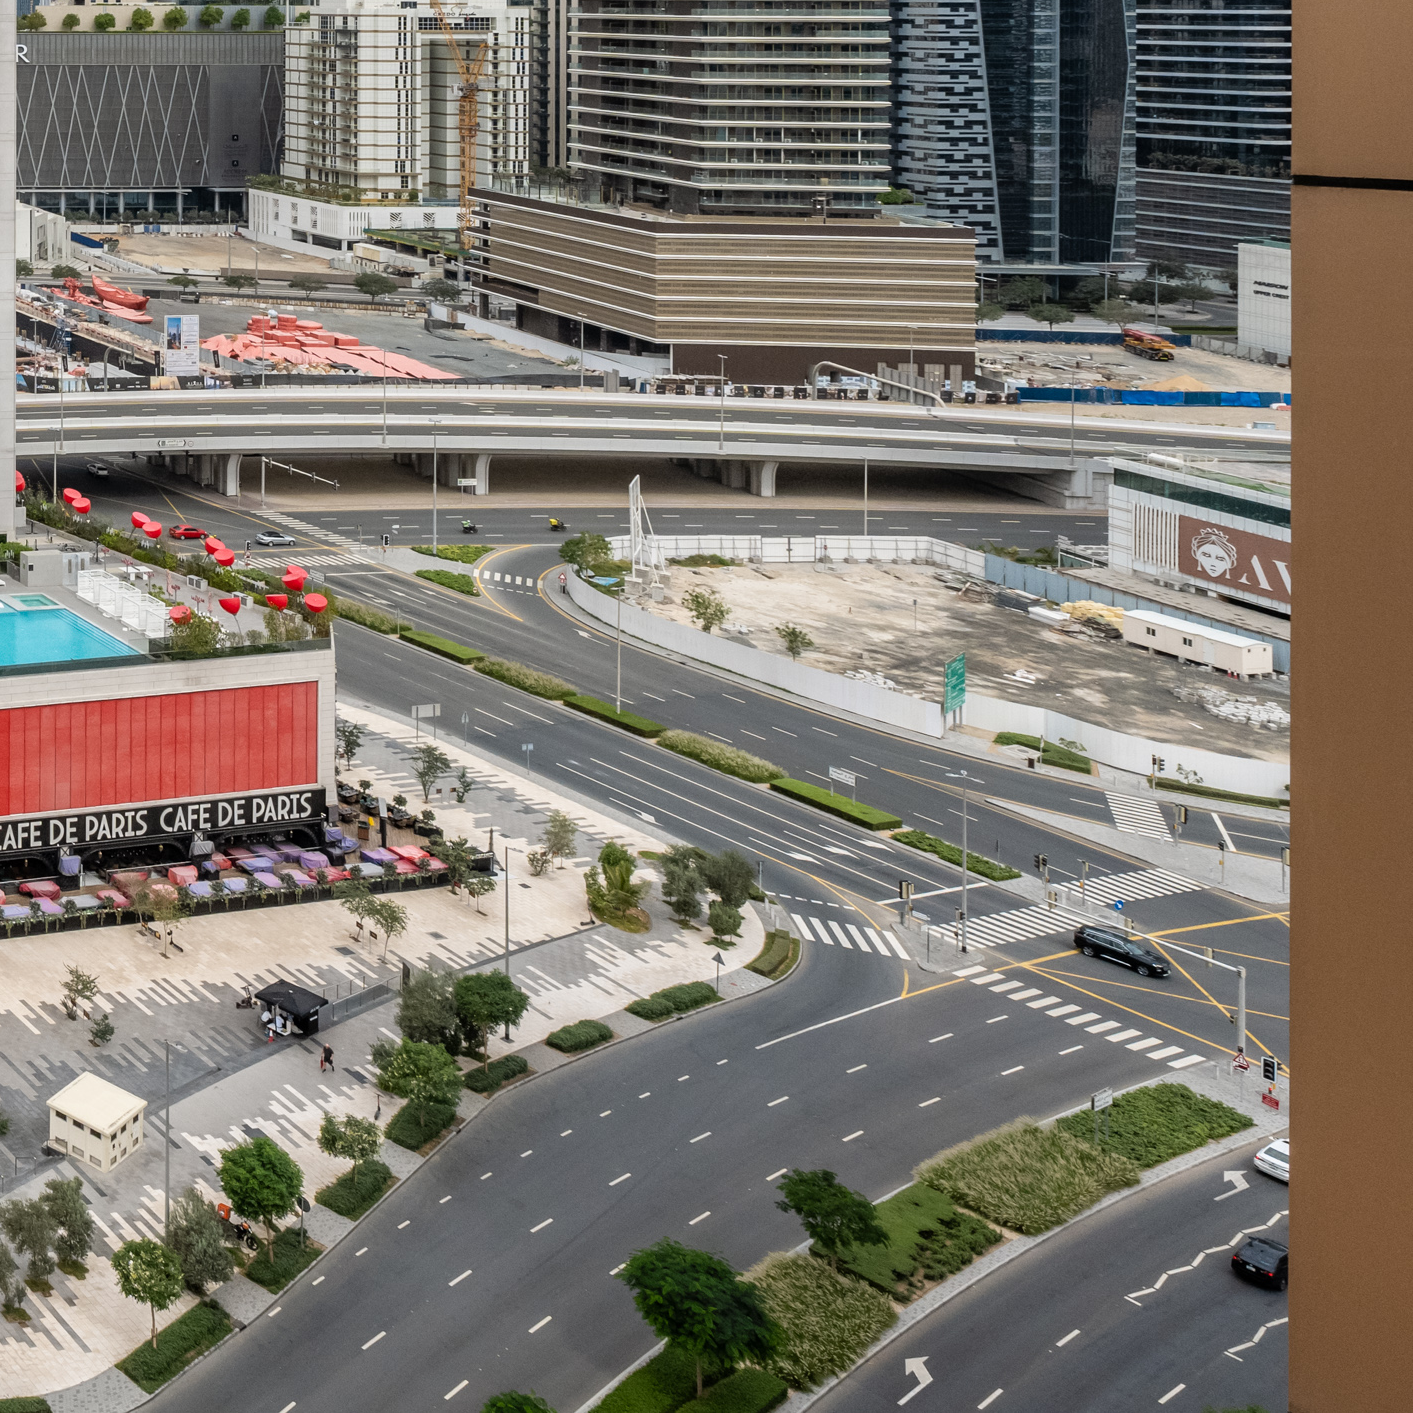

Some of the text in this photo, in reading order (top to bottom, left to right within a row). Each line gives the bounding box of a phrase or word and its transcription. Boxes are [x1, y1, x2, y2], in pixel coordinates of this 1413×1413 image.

[49, 817, 79, 846] DE
[85, 809, 148, 843] PARIS
[159, 802, 212, 833] CAFE
[217, 798, 246, 827] DE
[251, 792, 313, 824] PARIS
